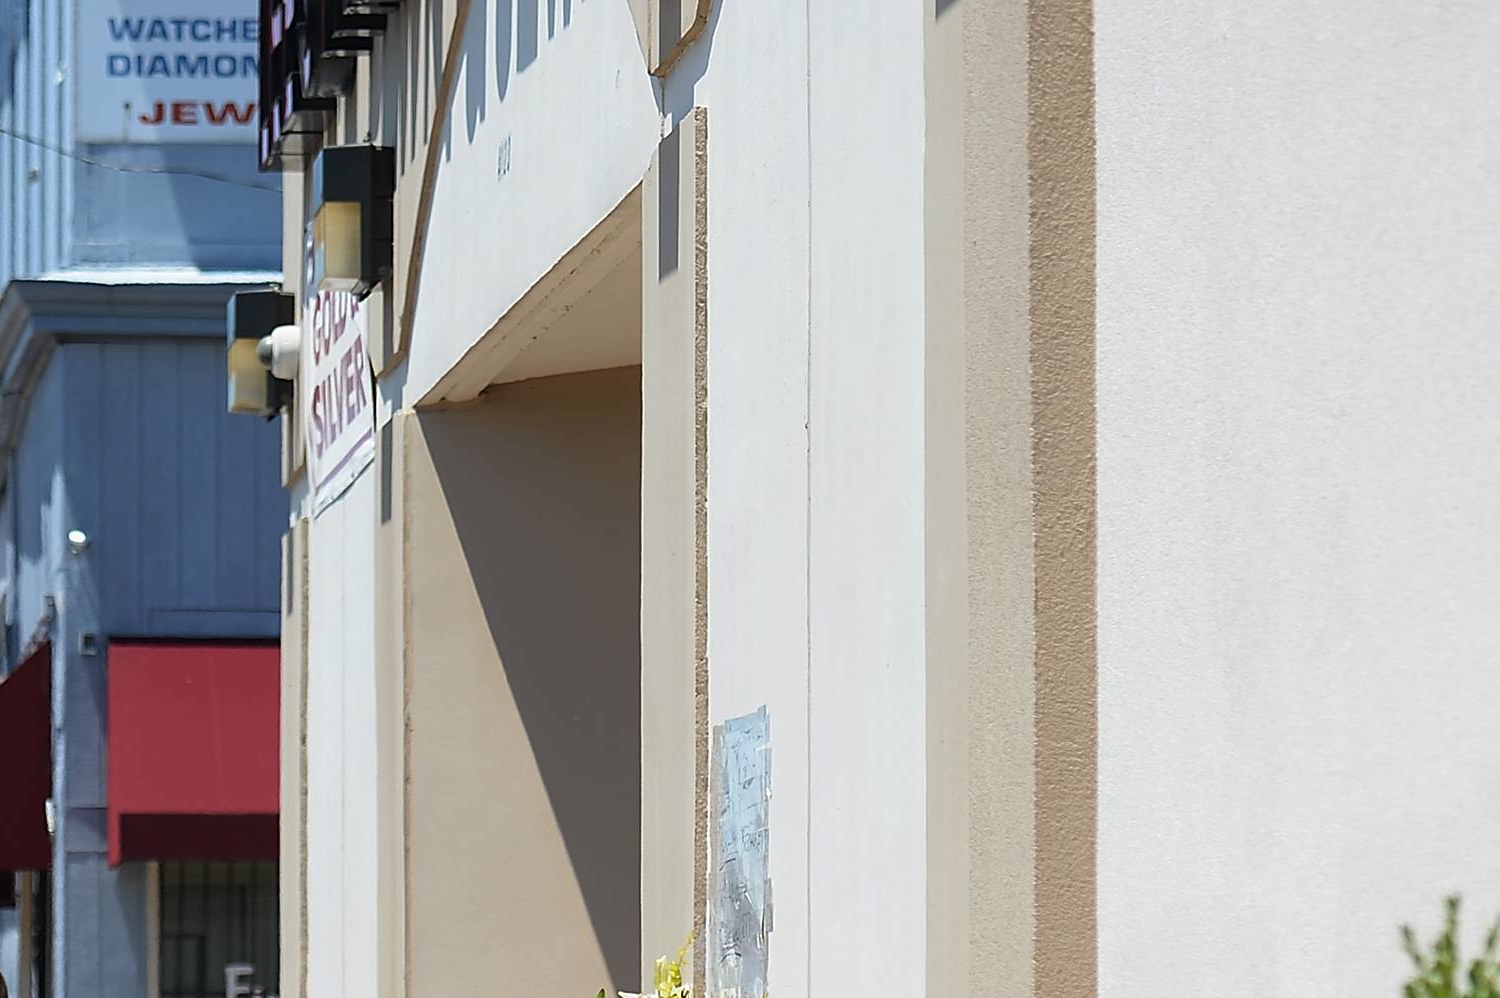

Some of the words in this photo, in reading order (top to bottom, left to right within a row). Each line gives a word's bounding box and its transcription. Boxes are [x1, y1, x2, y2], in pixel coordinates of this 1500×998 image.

[109, 18, 258, 42] WATCHE
[108, 54, 259, 79] DIAMON
[138, 101, 257, 126] JEW
[312, 334, 367, 460] SILVER
